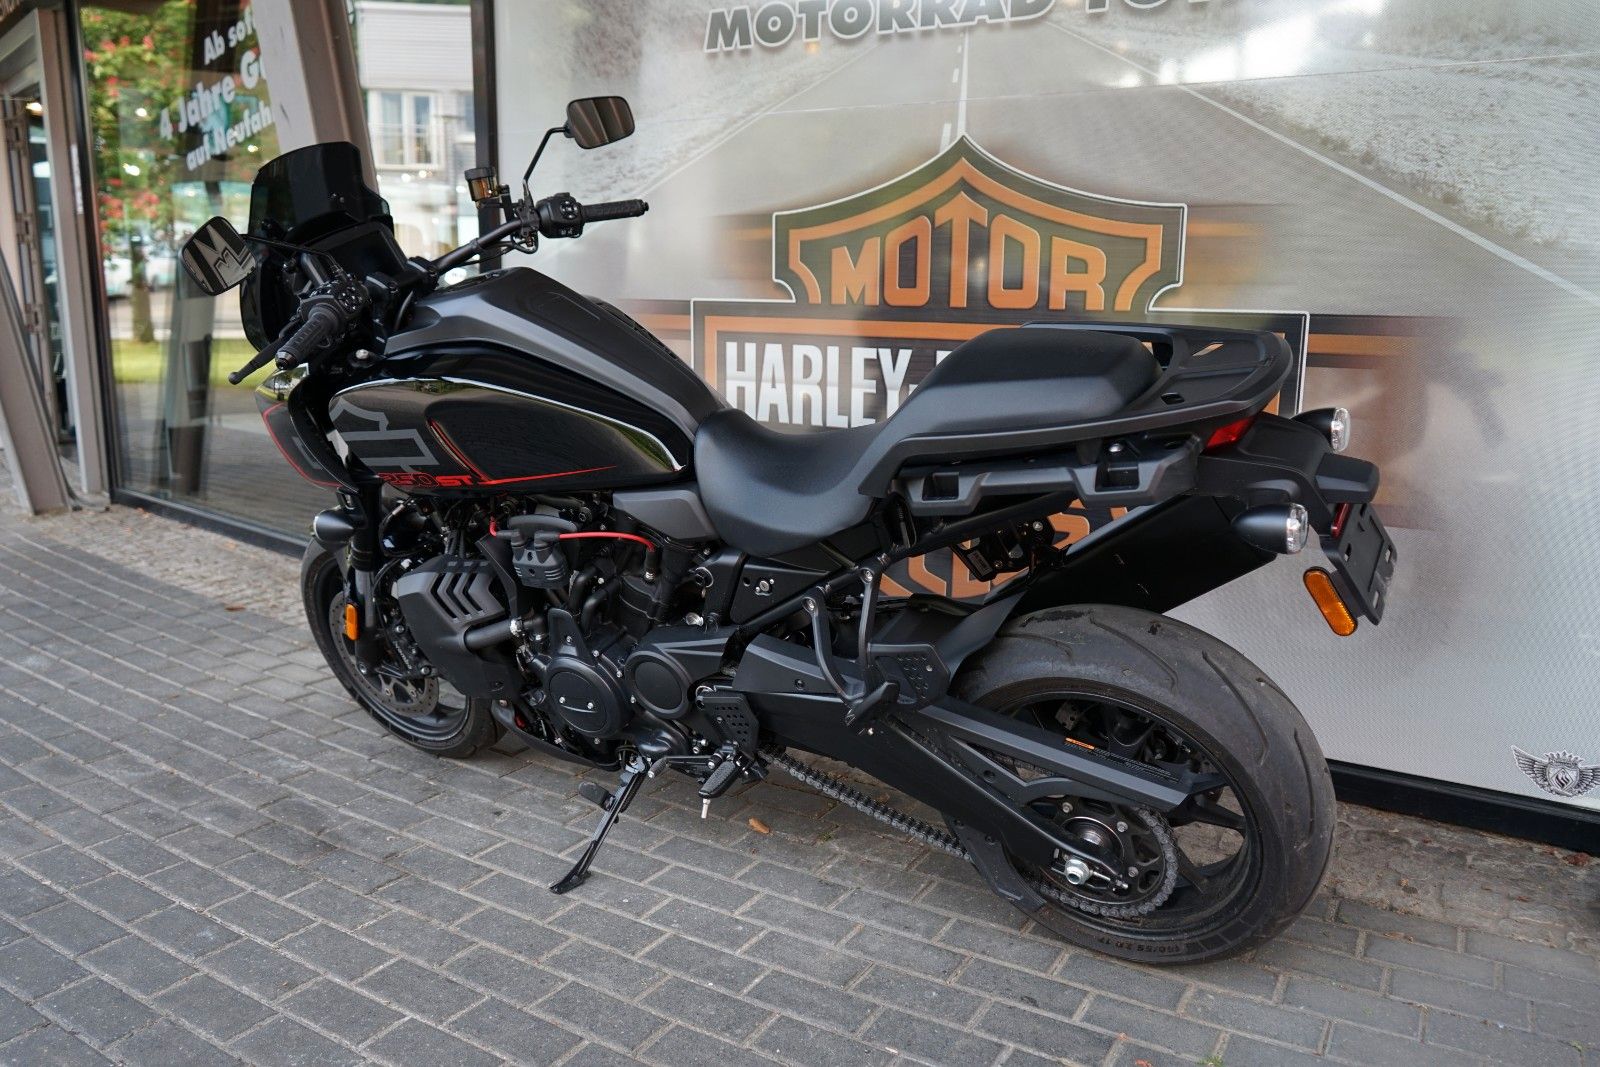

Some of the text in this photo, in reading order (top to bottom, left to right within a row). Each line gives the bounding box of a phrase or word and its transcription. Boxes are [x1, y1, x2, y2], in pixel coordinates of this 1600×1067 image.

[204, 5, 256, 65] Ab sof
[178, 75, 235, 133] Jahre
[186, 101, 272, 171] auf Neufah
[830, 192, 1106, 311] MOTOR
[725, 341, 952, 429] HARLEY-
